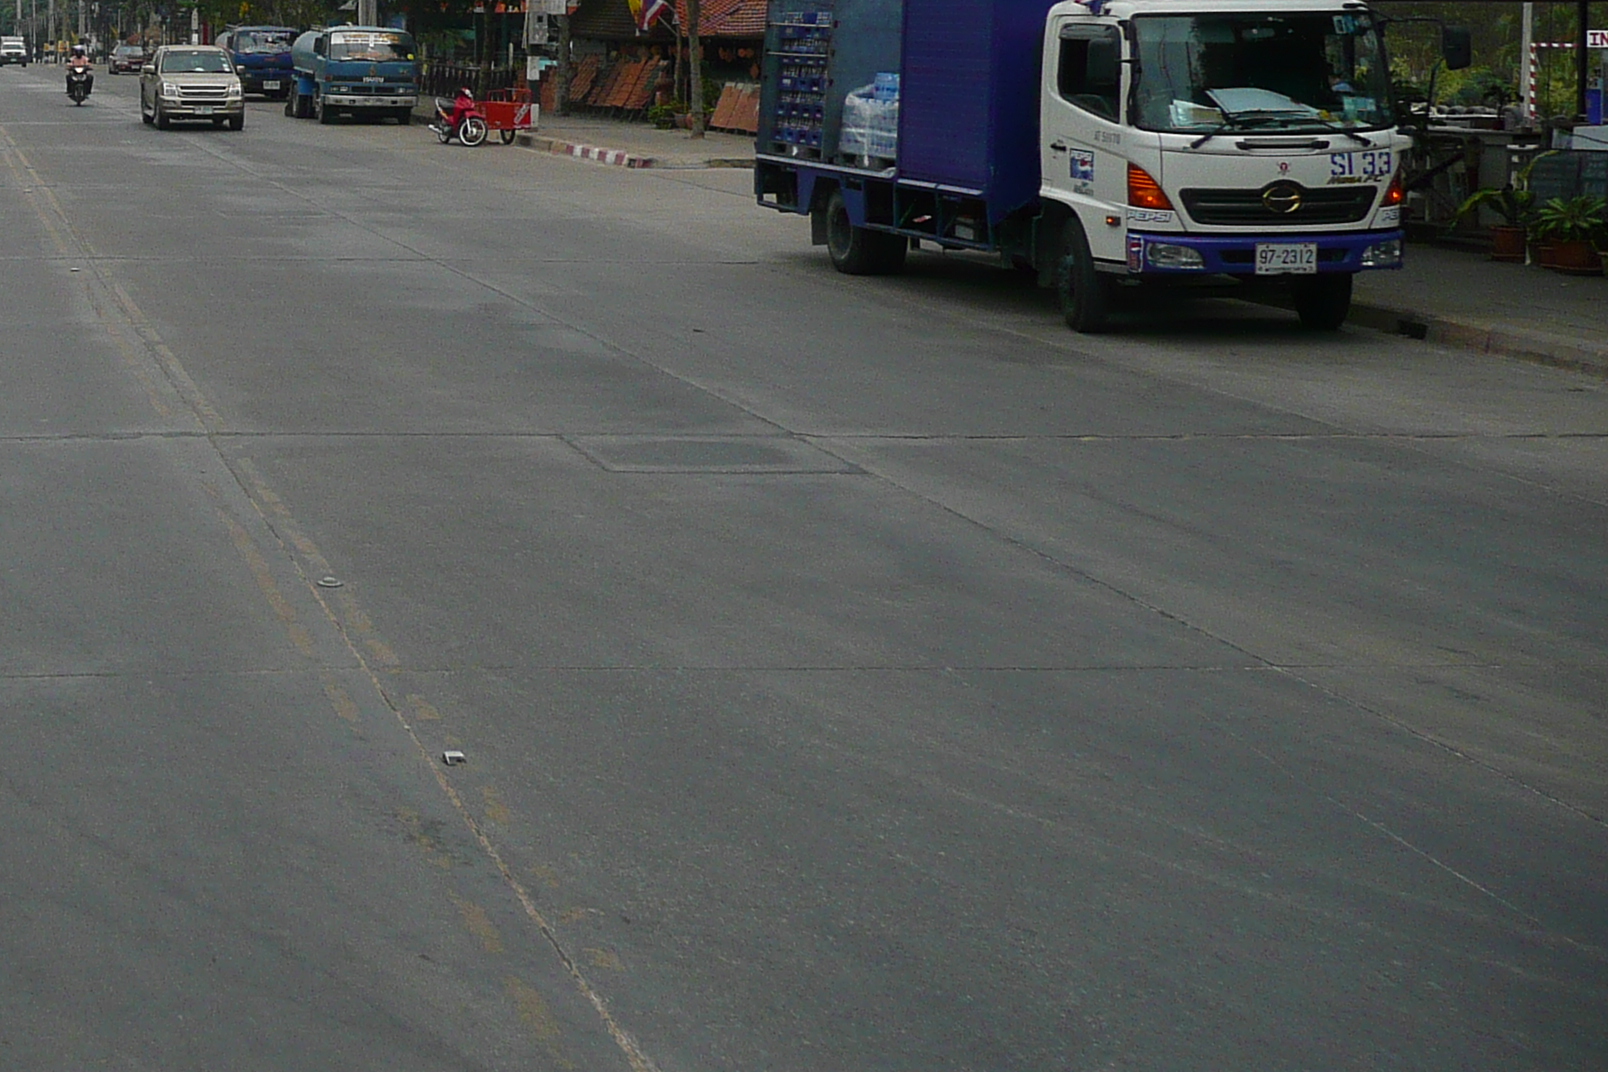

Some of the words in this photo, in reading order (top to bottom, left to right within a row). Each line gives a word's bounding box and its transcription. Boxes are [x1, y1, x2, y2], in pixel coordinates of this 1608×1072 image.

[1362, 151, 1391, 175] 33
[1127, 211, 1173, 223] PEPSI
[1259, 249, 1314, 264] 97-2312
